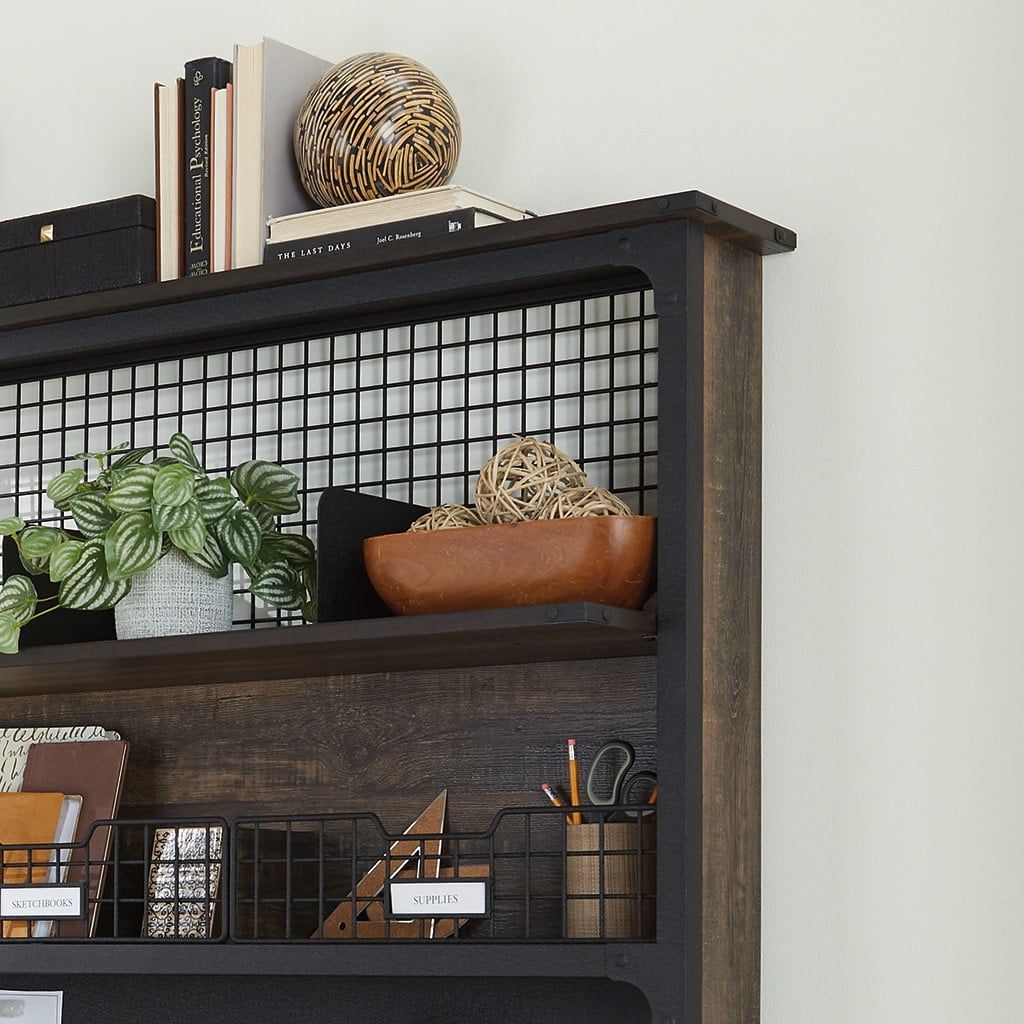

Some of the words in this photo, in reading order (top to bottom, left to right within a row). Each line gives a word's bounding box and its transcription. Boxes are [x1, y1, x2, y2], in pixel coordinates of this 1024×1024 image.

[189, 97, 203, 171] Psychology
[189, 174, 203, 253] Educational
[376, 236, 387, 245] Joel
[387, 234, 394, 242] C.
[277, 251, 296, 260] THE
[300, 247, 323, 257] LAST
[328, 242, 352, 252] DAYS
[11, 898, 73, 909] SKETCHBOOKS
[413, 894, 458, 905] SUPPLIES
